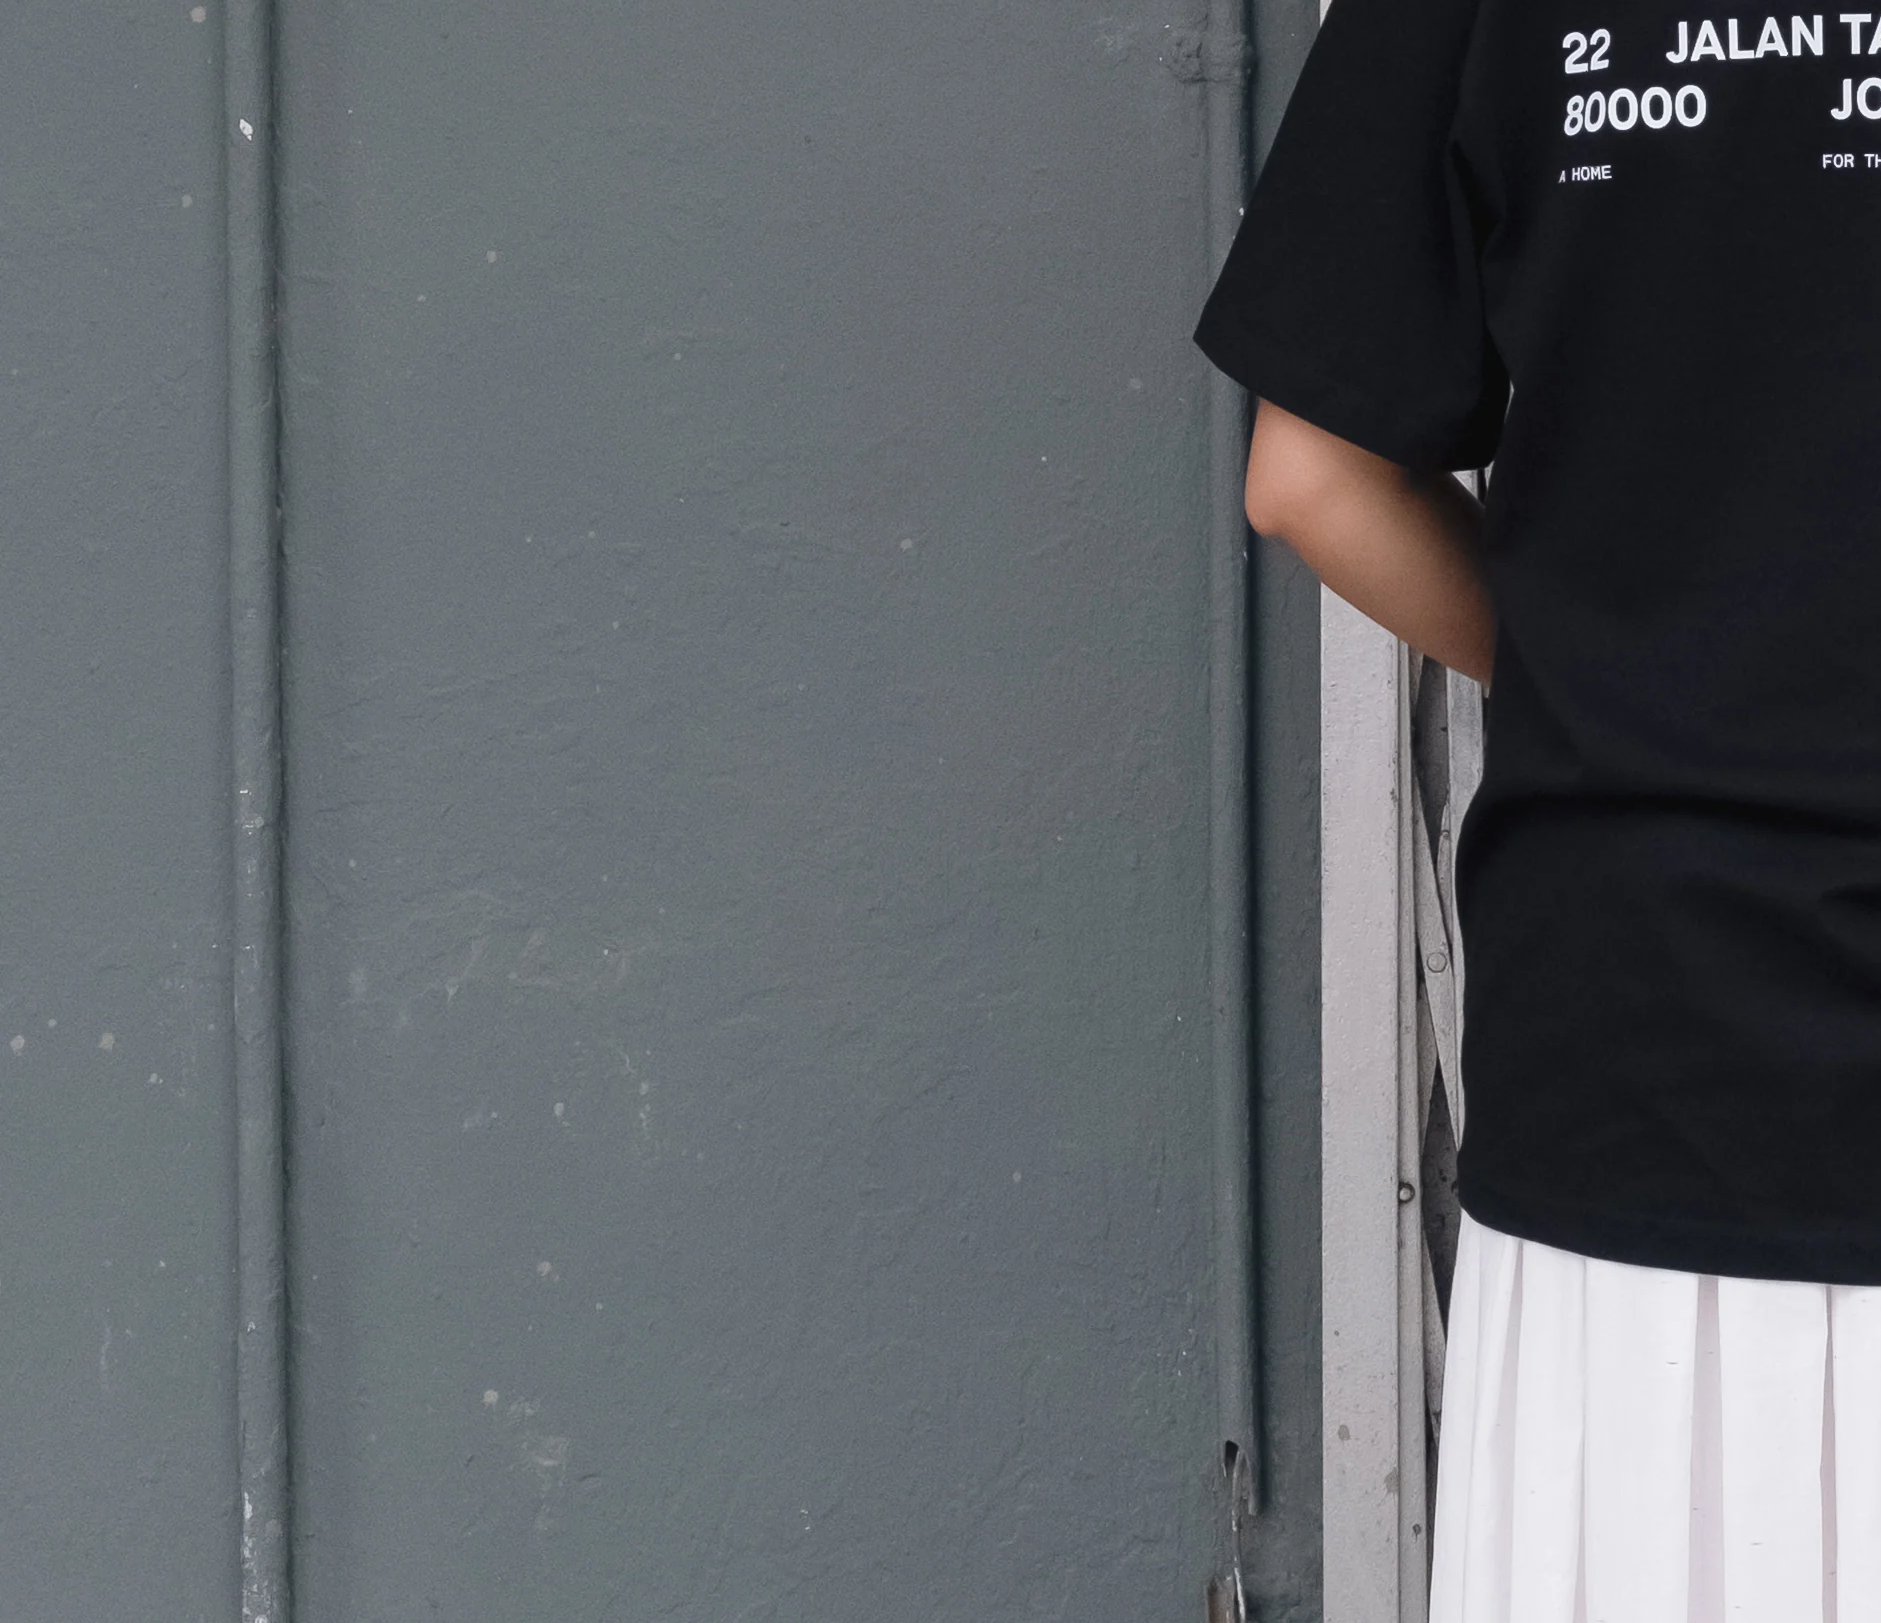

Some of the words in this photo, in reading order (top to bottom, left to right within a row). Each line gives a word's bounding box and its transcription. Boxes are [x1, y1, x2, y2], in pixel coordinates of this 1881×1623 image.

[1562, 28, 1611, 75] 22
[1665, 14, 1824, 64] JALAN
[1563, 84, 1707, 137] 80000
[1571, 164, 1613, 182] HOME
[1822, 153, 1855, 169] FOR
